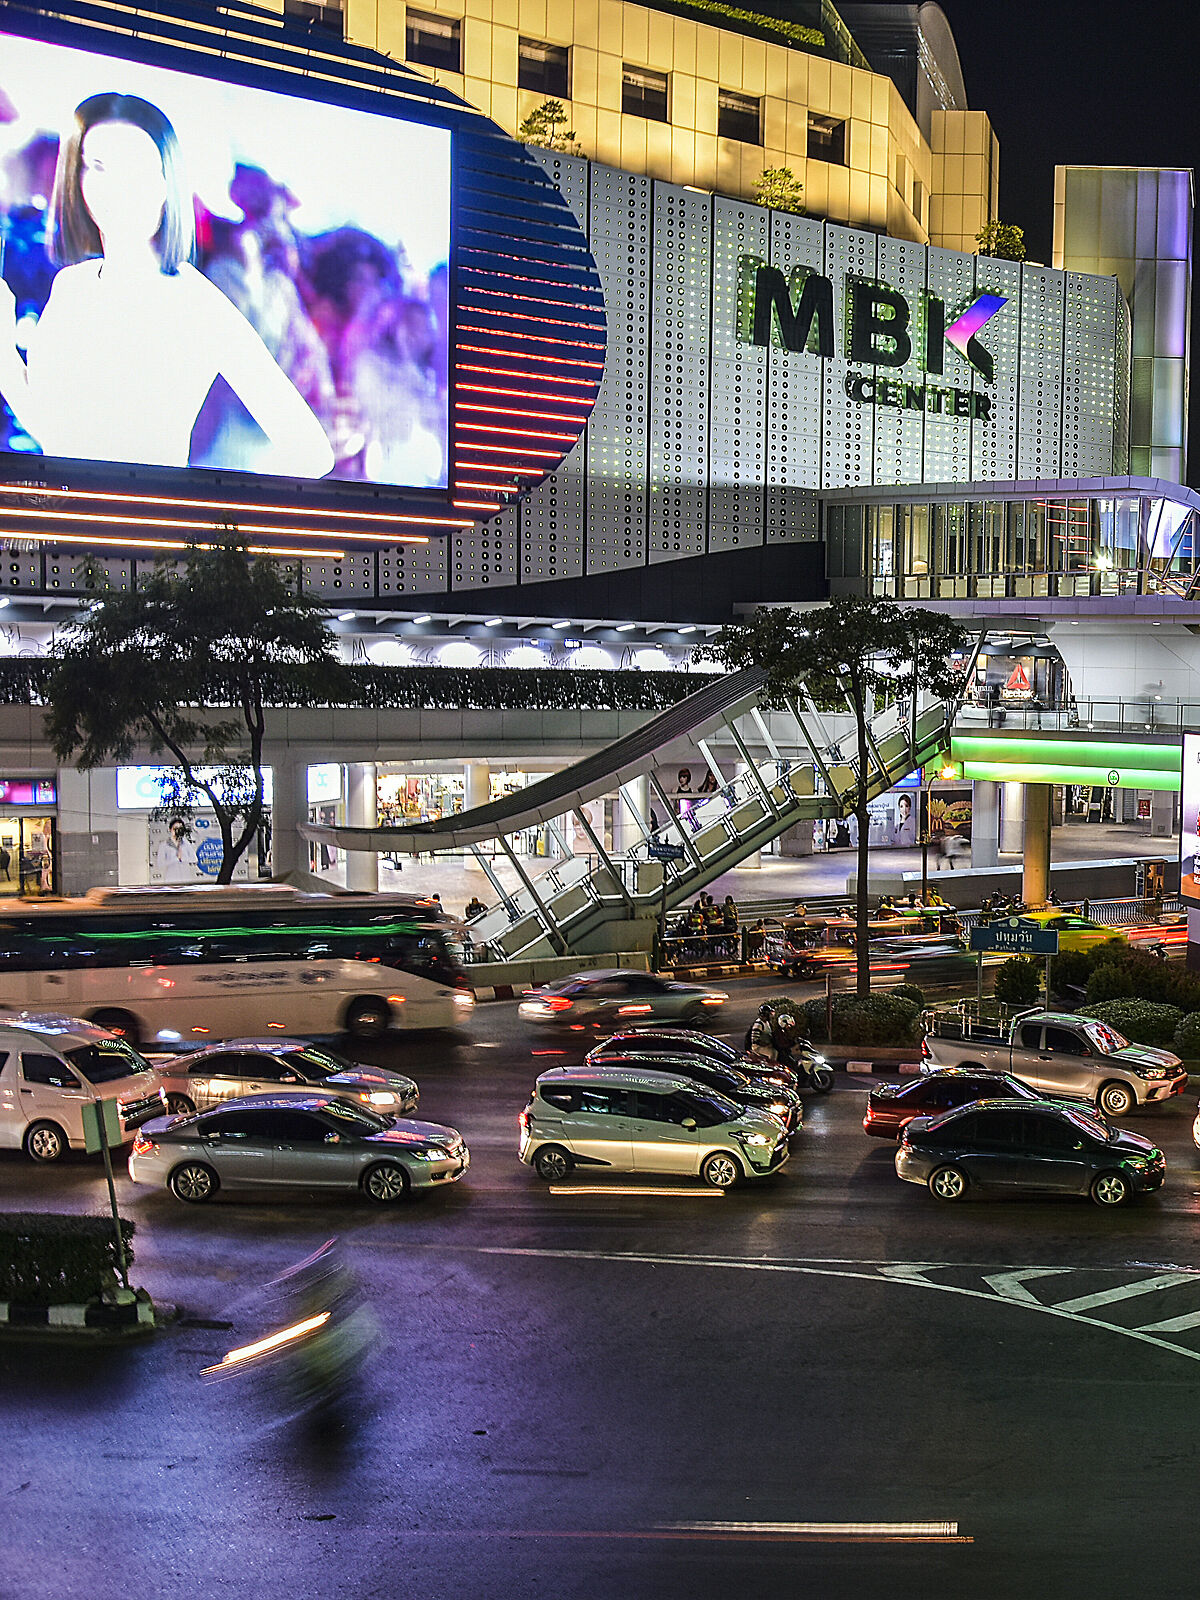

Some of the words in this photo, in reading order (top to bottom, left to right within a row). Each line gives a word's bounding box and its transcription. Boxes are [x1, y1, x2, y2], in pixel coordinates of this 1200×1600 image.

[738, 257, 1010, 385] MBK
[846, 372, 993, 422] CENTER
[1002, 688, 1034, 699] Reebok
[995, 930, 1033, 945] ปทุมวัน
